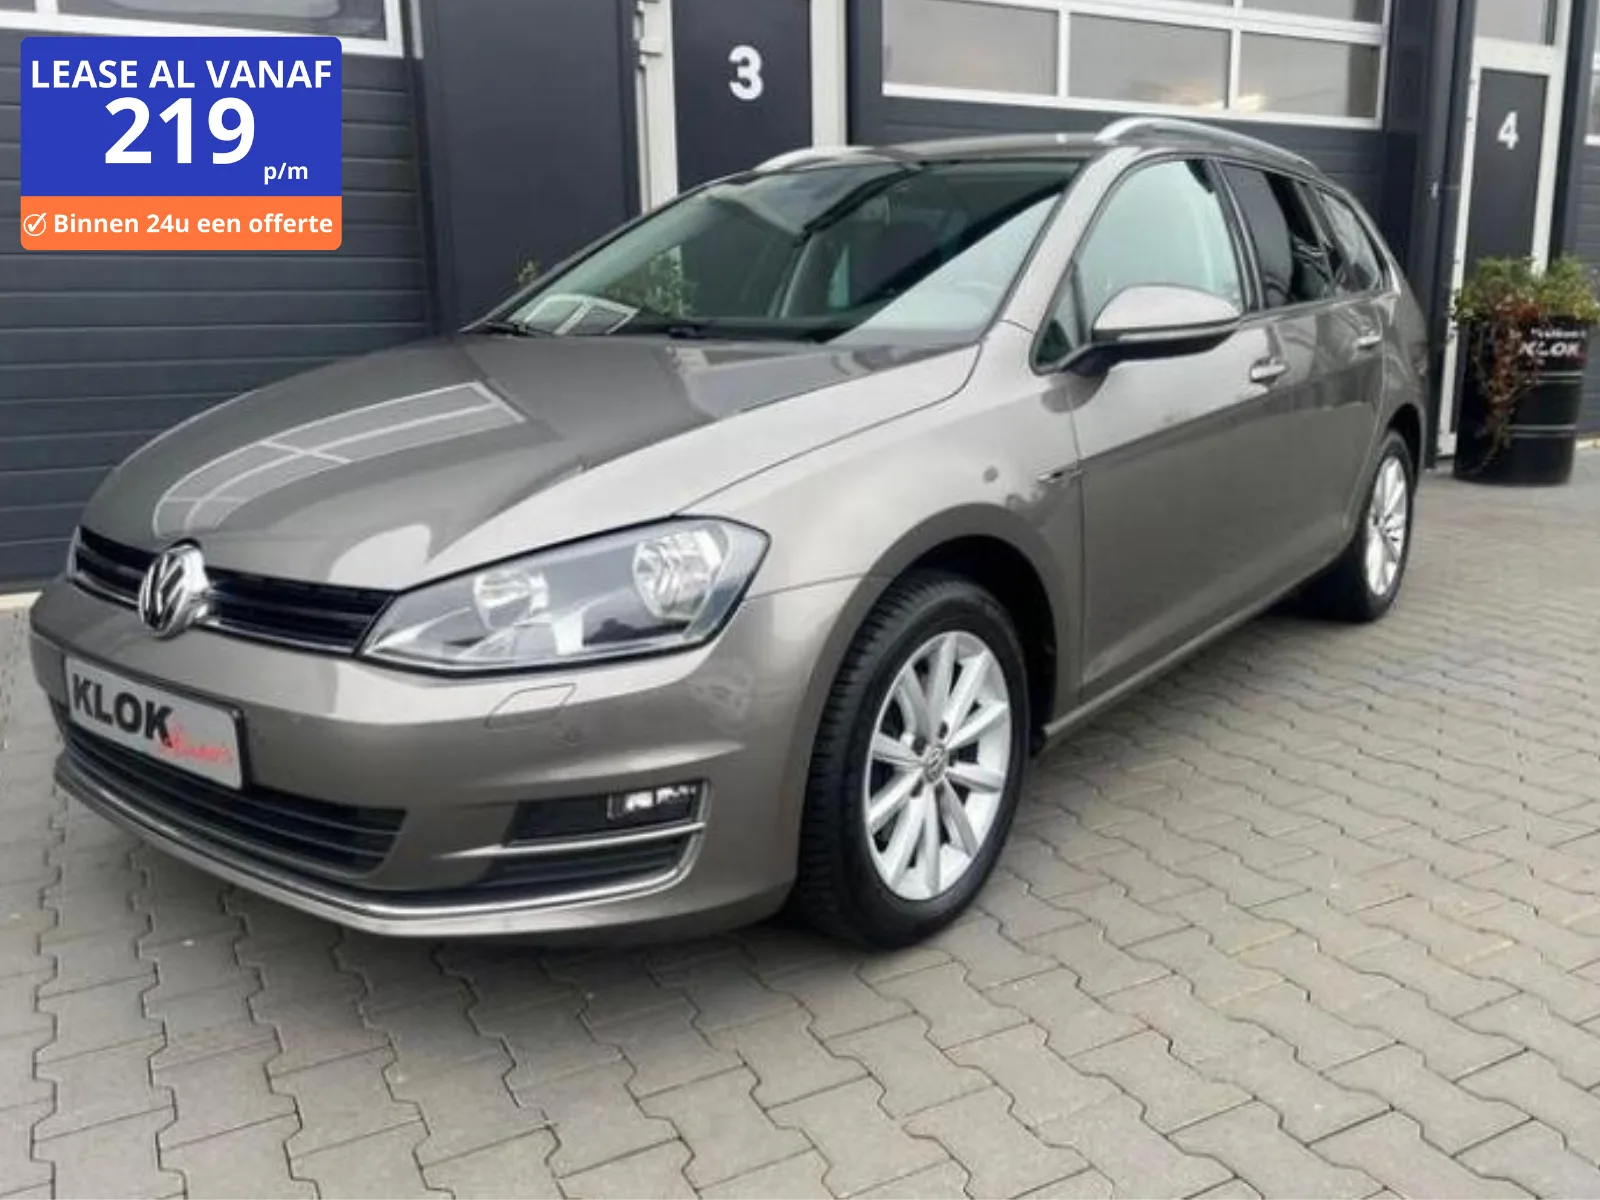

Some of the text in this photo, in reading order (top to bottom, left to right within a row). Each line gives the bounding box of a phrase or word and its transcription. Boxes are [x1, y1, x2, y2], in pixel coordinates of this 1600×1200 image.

[728, 44, 764, 101] 3
[1497, 110, 1519, 150] 4
[72, 672, 174, 748] KLOK
